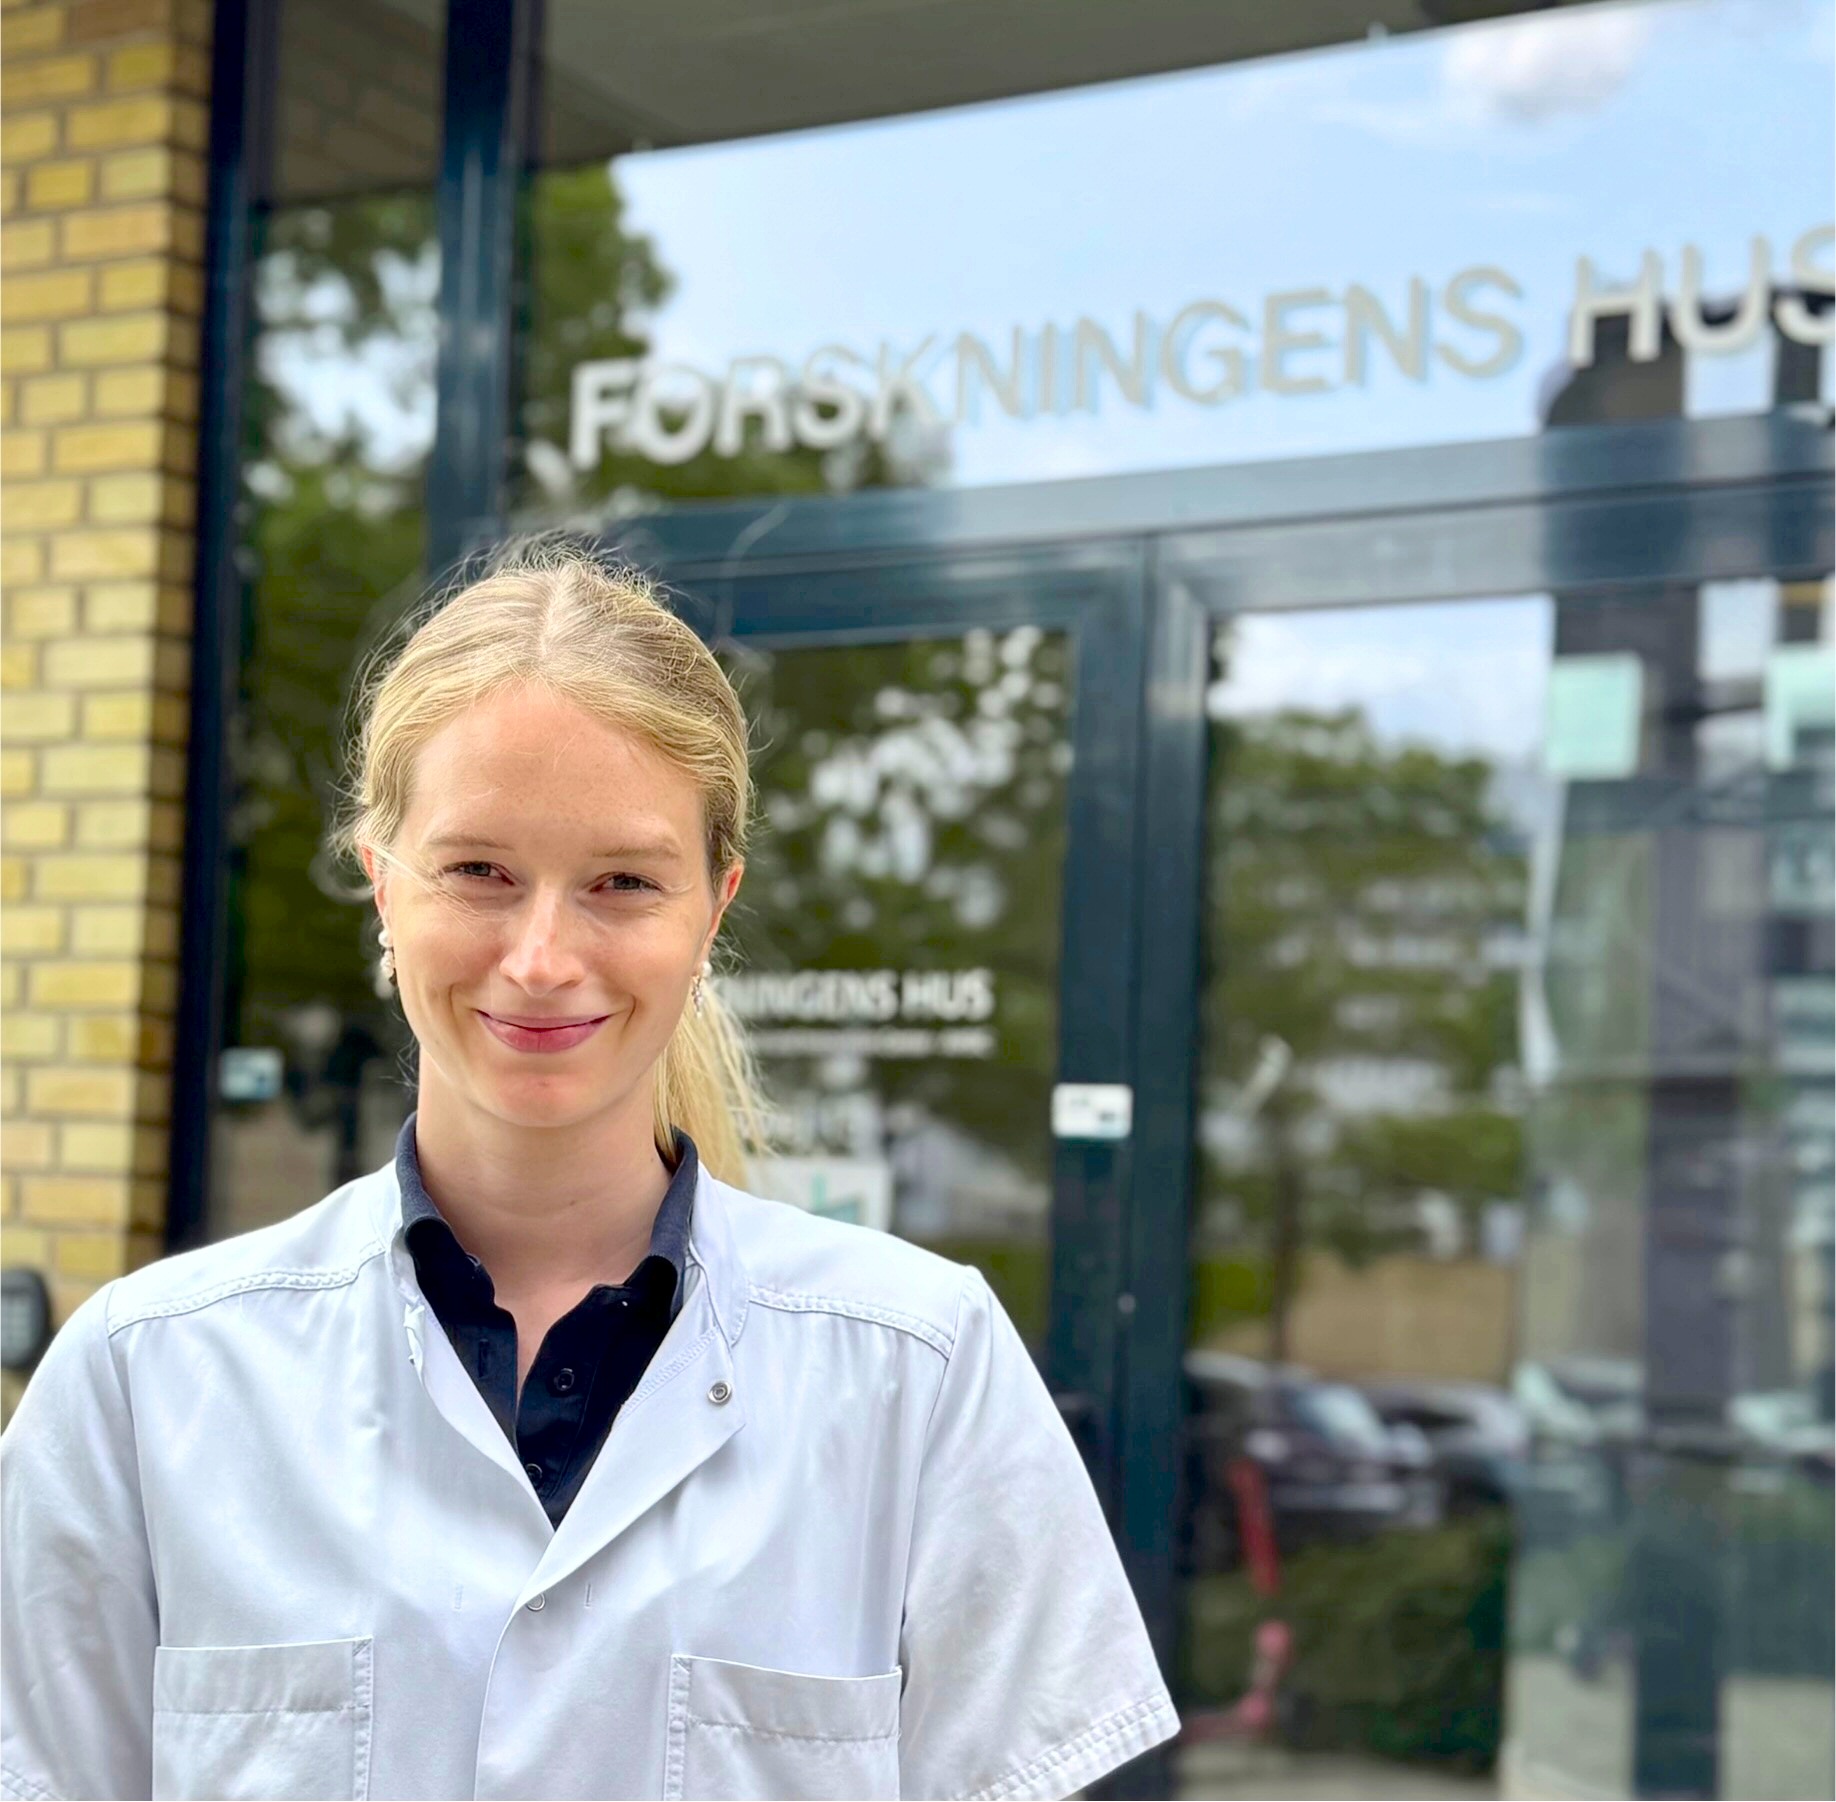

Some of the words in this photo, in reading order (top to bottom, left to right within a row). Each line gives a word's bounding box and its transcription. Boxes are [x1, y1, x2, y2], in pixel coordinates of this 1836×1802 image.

[569, 265, 1525, 470] FORSKNINGENS
[1567, 223, 1835, 368] HUS
[901, 968, 995, 1021] HUS
